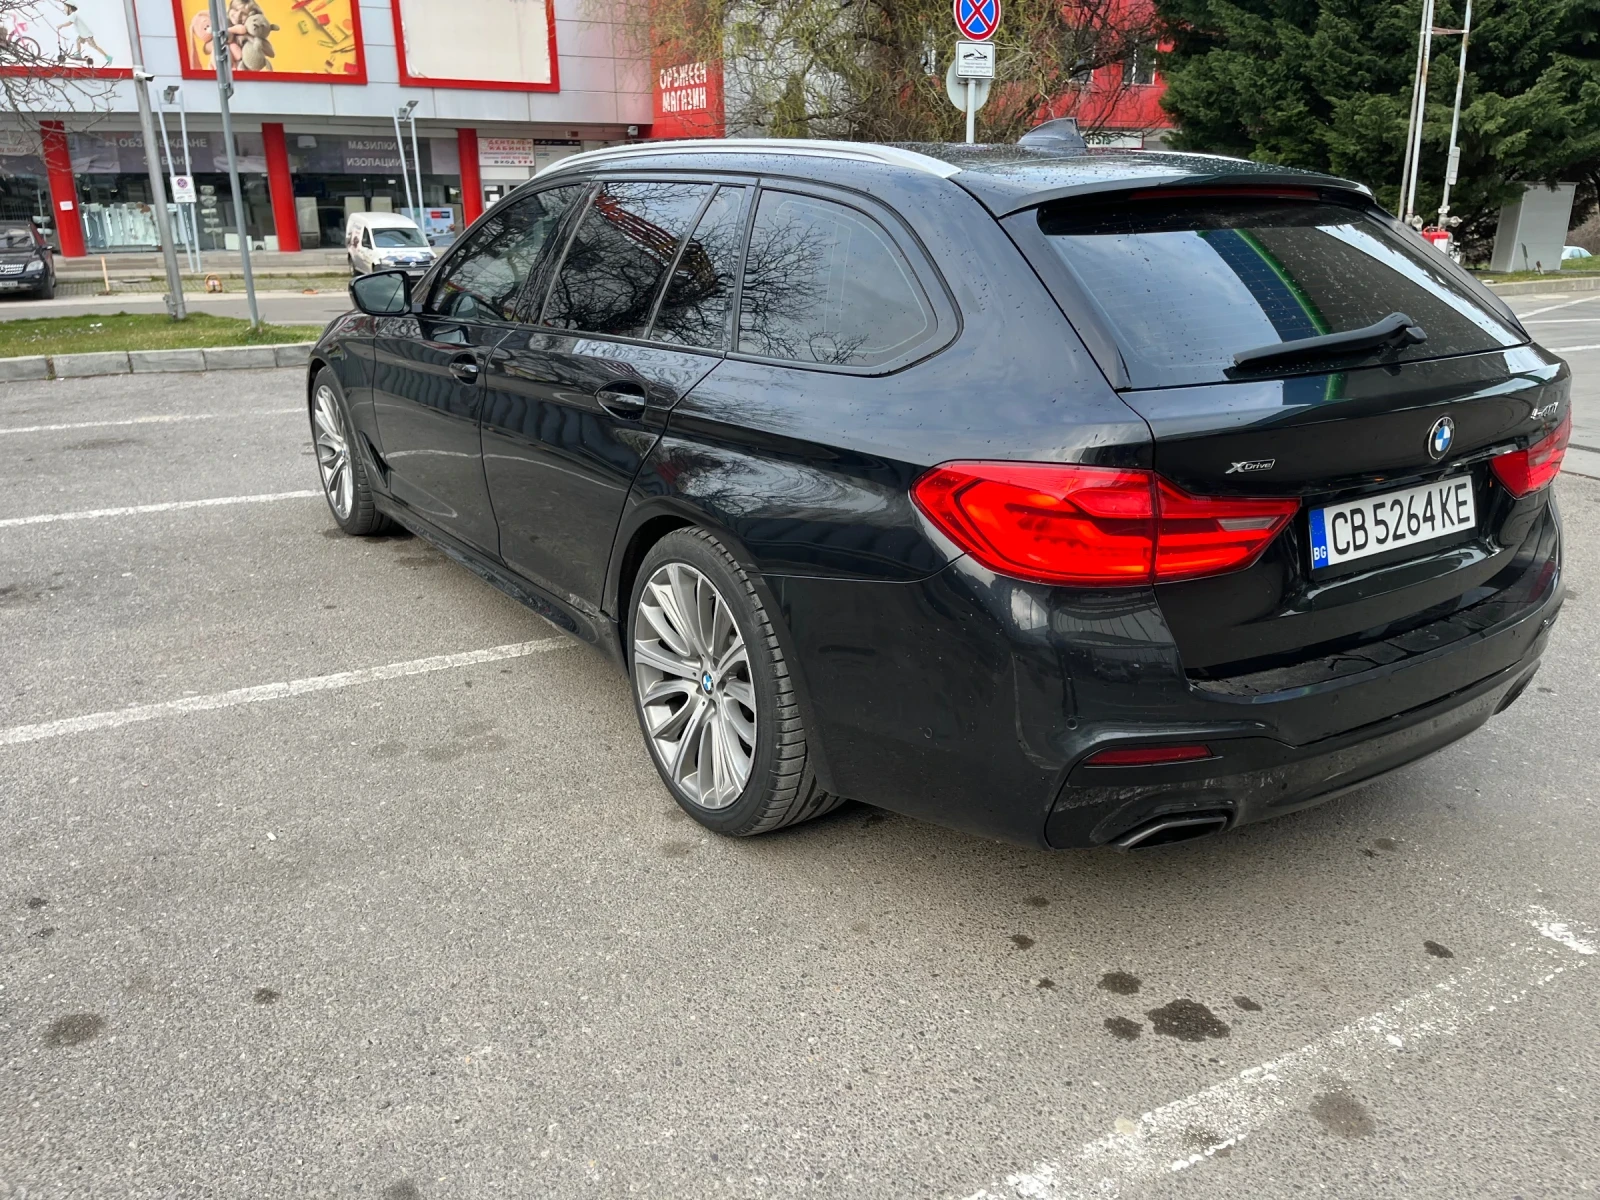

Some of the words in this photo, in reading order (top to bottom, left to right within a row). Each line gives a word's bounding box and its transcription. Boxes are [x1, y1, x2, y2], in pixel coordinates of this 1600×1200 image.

[660, 61, 707, 90] ОРЪЖЕЕН
[662, 86, 707, 112] МАГАЗИН
[348, 140, 397, 151] МАЗИЛКИ
[1313, 545, 1327, 561] BG
